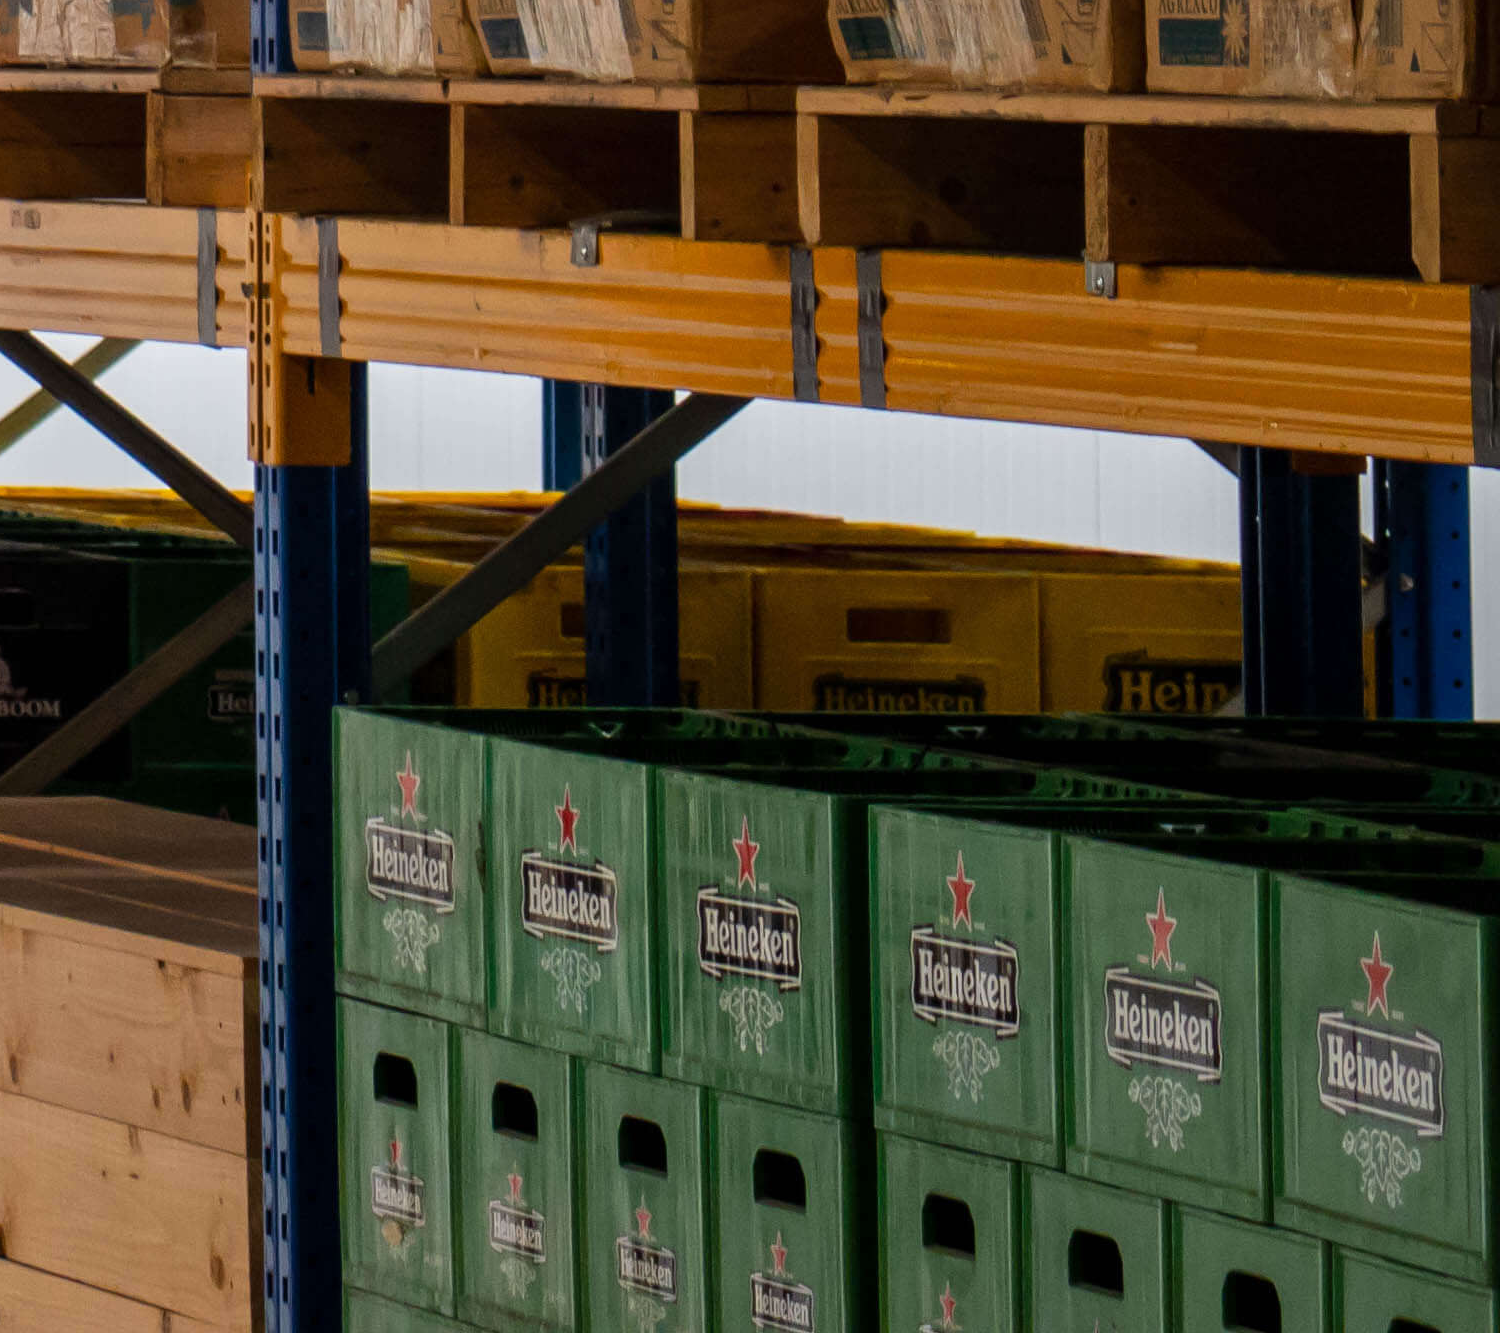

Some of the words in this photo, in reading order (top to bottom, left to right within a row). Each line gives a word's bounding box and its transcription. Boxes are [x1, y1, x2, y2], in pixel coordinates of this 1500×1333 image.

[1118, 668, 1238, 713] Hein
[372, 835, 449, 893] Heineken
[527, 869, 611, 931] Heineken
[704, 908, 796, 968] Heineken
[918, 947, 1013, 1014] Heineken
[1113, 987, 1215, 1058] Heineken
[1326, 1033, 1436, 1112] Heineken
[492, 1210, 543, 1251] Heineken
[620, 1247, 674, 1288] Heineken
[754, 1283, 810, 1325] Heineken
